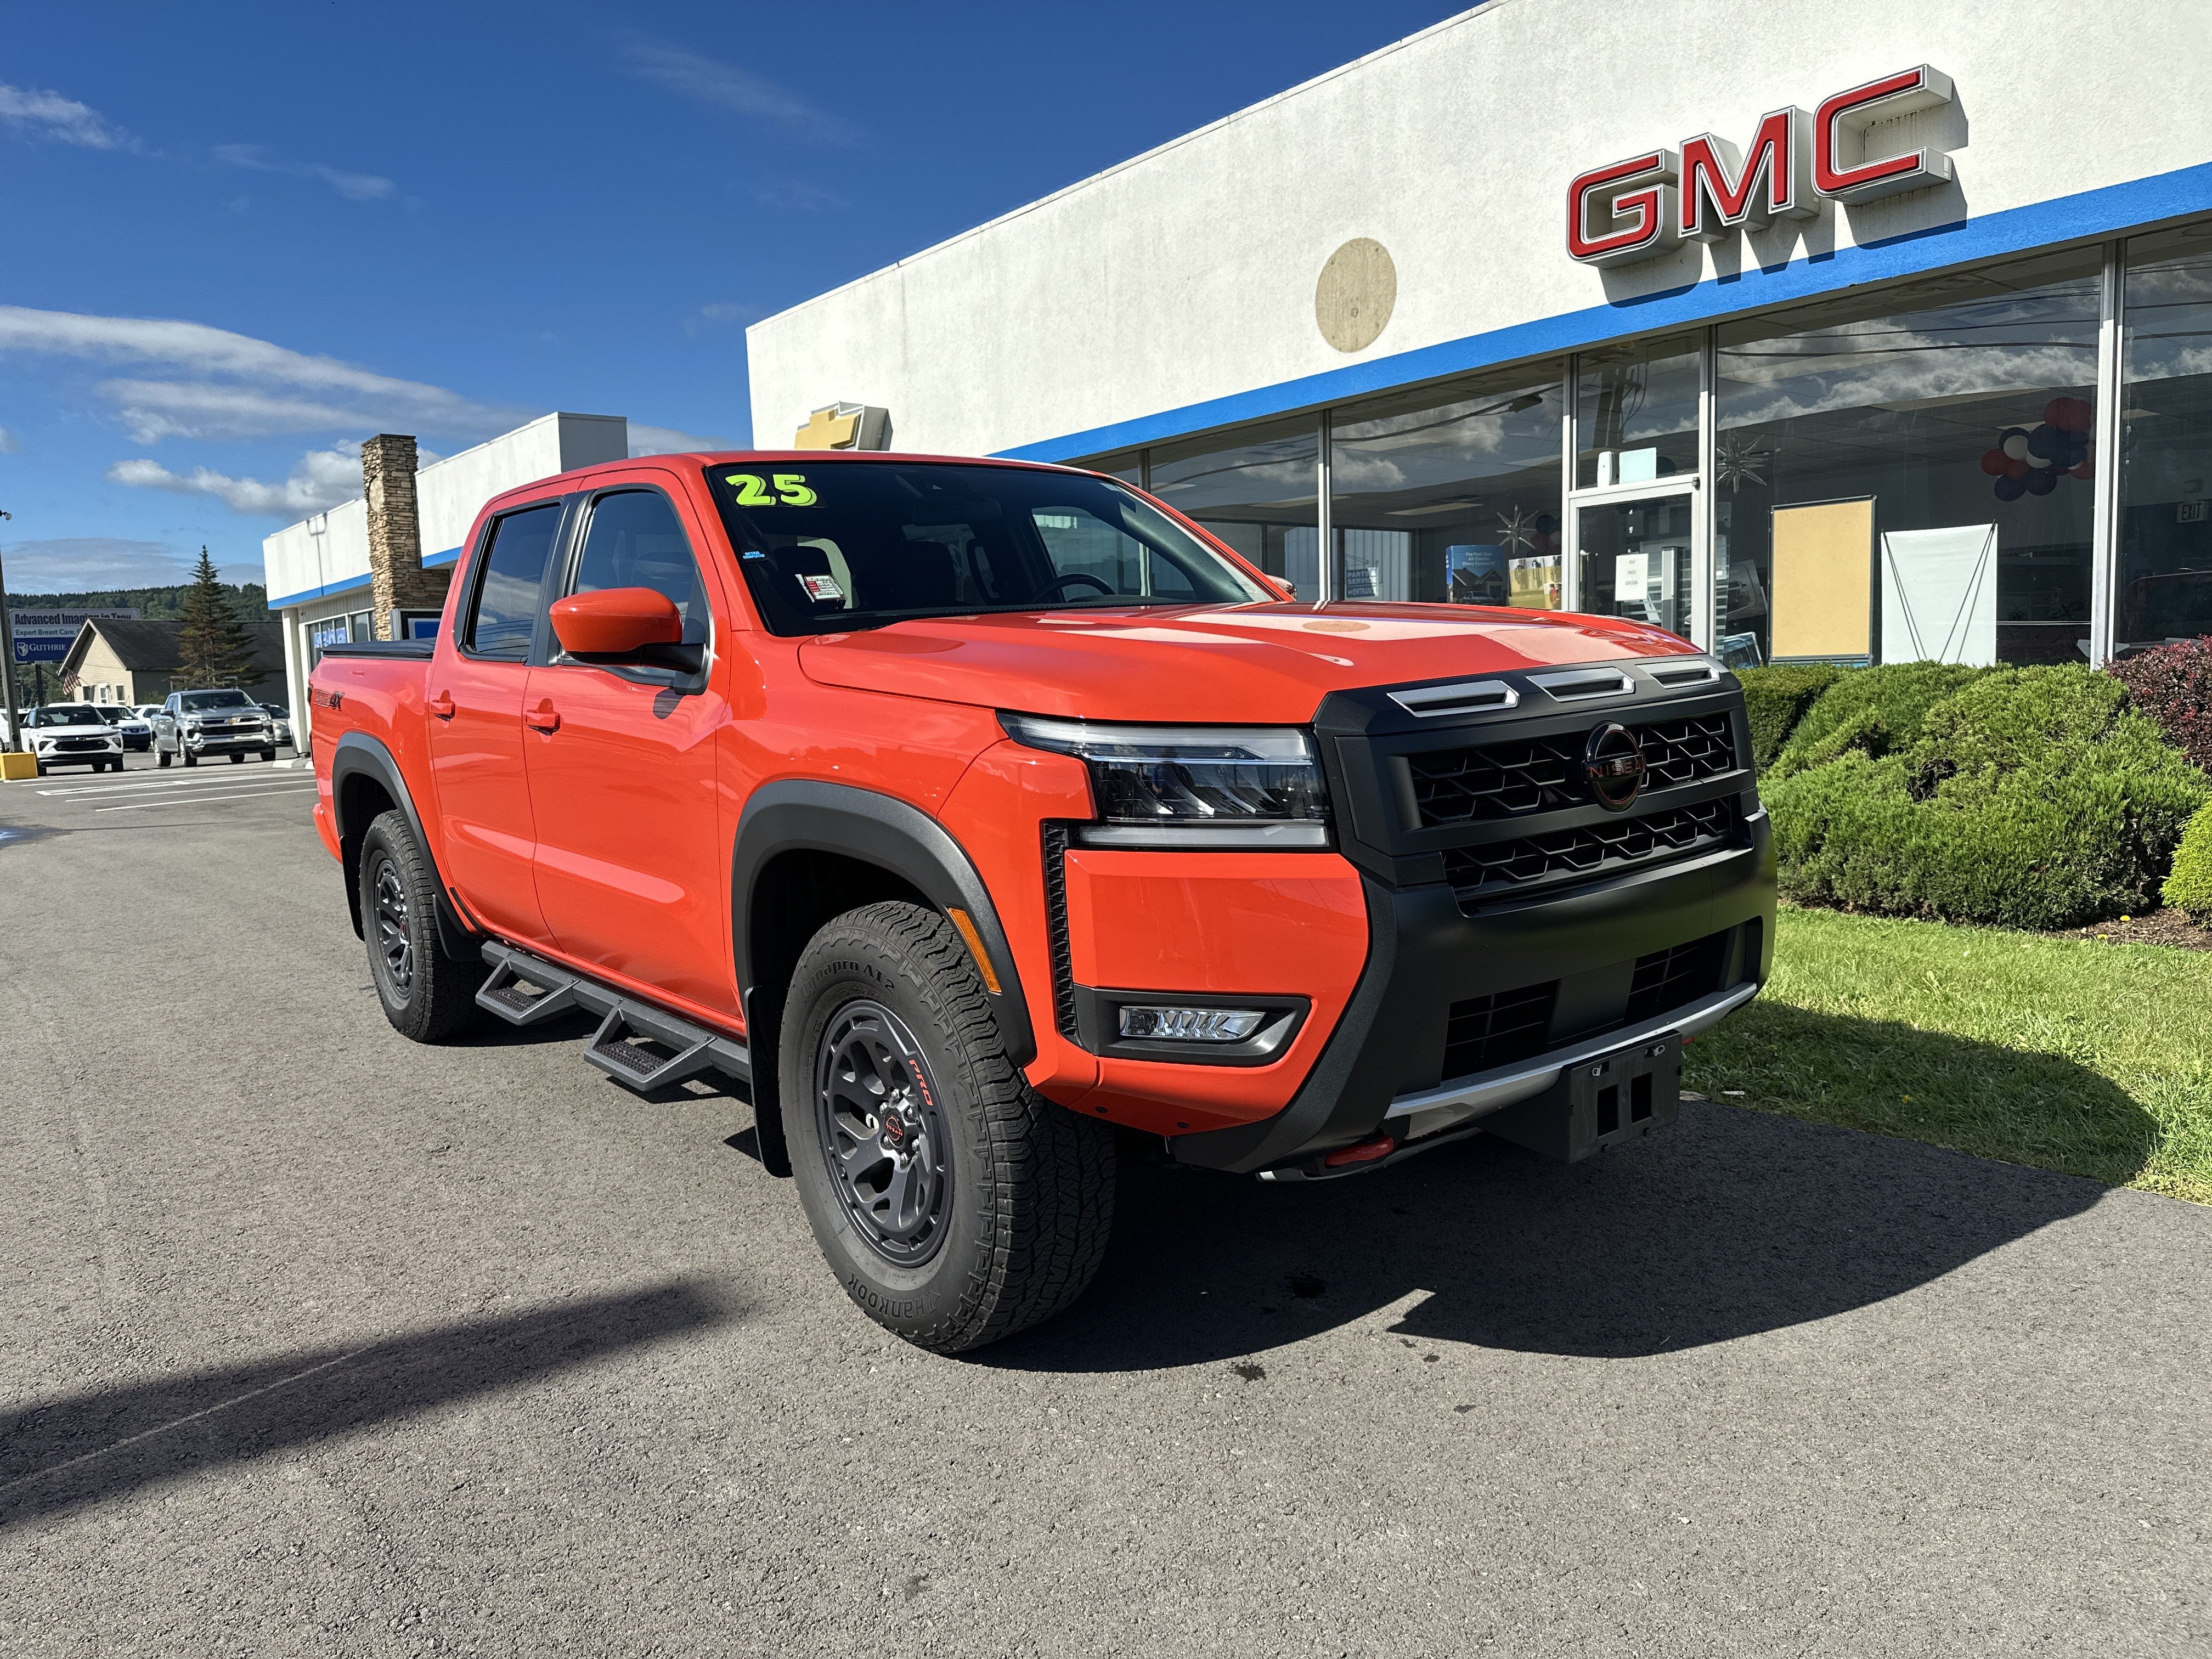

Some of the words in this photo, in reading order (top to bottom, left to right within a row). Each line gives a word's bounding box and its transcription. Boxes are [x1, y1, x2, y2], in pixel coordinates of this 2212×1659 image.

[1566, 63, 1930, 264] GMC
[725, 474, 817, 506] 25
[2181, 503, 2202, 521] EXIT
[1347, 577, 1377, 585] SERVICE
[15, 613, 60, 625] Advanced
[29, 643, 67, 652] GUTHRIE
[799, 961, 859, 1003] Dynapro
[909, 1059, 933, 1106] PRO
